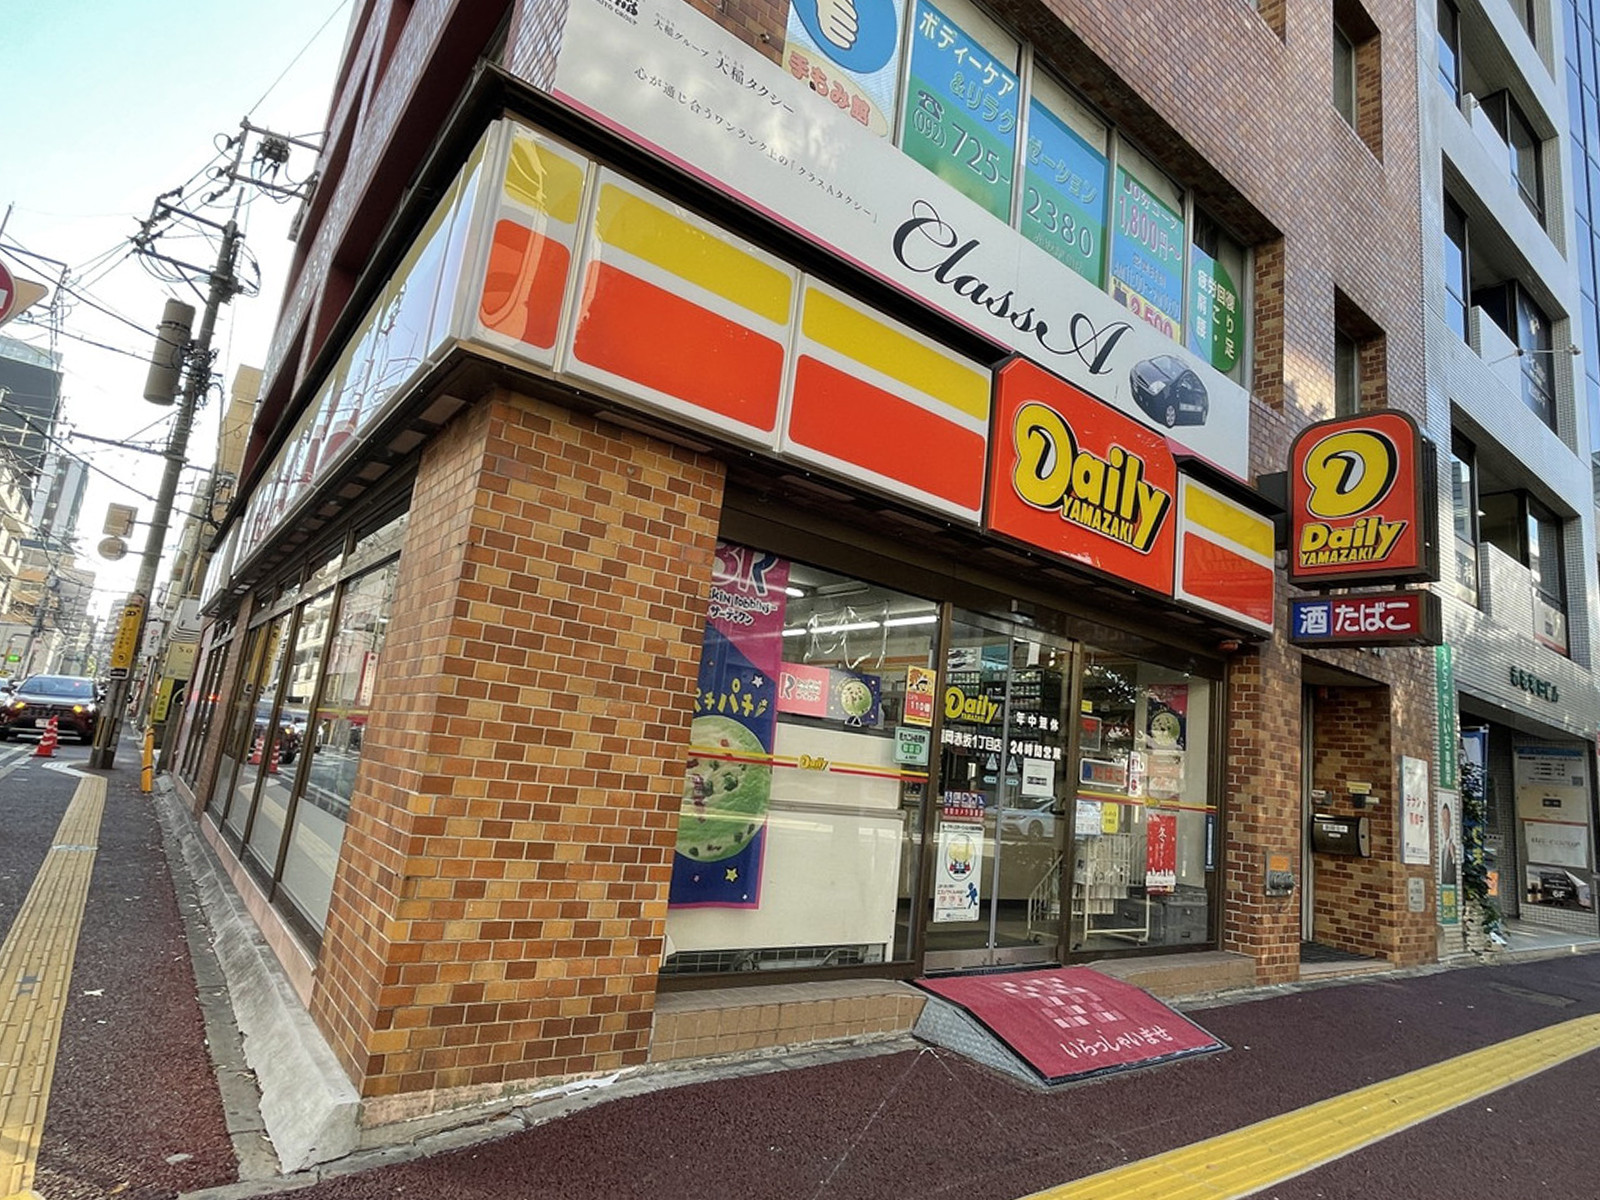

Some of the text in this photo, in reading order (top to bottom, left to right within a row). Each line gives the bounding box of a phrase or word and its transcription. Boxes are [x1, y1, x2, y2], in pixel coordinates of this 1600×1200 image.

[918, 11, 1015, 97] ボディーケア
[1025, 187, 1095, 259] 2380
[1014, 402, 1168, 552] Daily
[1062, 493, 1135, 544] YAMAZAKI
[1301, 547, 1374, 566] YAMAZAKI
[1302, 517, 1406, 560] Daily
[709, 605, 753, 625] サーティワン
[1299, 600, 1411, 635] 酒 たばこ
[945, 686, 998, 724] Daily
[1016, 711, 1060, 731] 年中無休
[1010, 740, 1062, 760] 24時間営業
[1060, 1024, 1174, 1059] いらっしゃいませ
